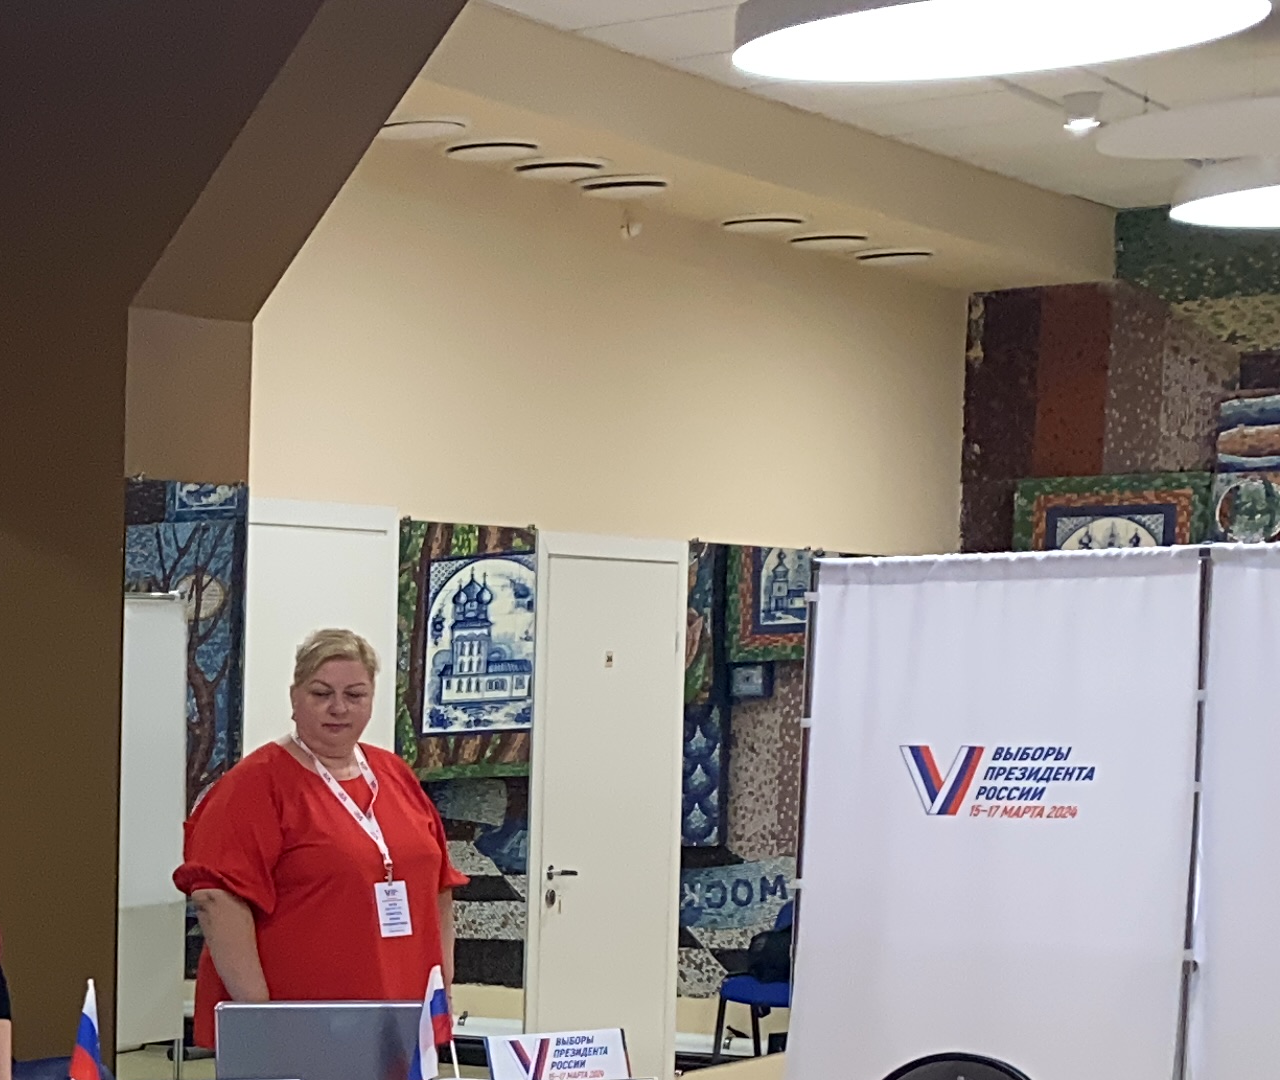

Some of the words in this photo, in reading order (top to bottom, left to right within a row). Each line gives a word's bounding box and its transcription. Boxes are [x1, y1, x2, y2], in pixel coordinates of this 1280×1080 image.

[991, 746, 1073, 762] ВЫБОРЫ
[983, 766, 1096, 783] ПРЕЗИДЕНТА
[976, 786, 1047, 801] РОССИИ
[999, 806, 1045, 818] МАРТА
[1046, 805, 1079, 819] 2024
[555, 1035, 595, 1047] ВЫБОРЫ
[553, 1046, 609, 1059] ПРЕЗИДЕНТА
[550, 1059, 587, 1071] РОССИИ
